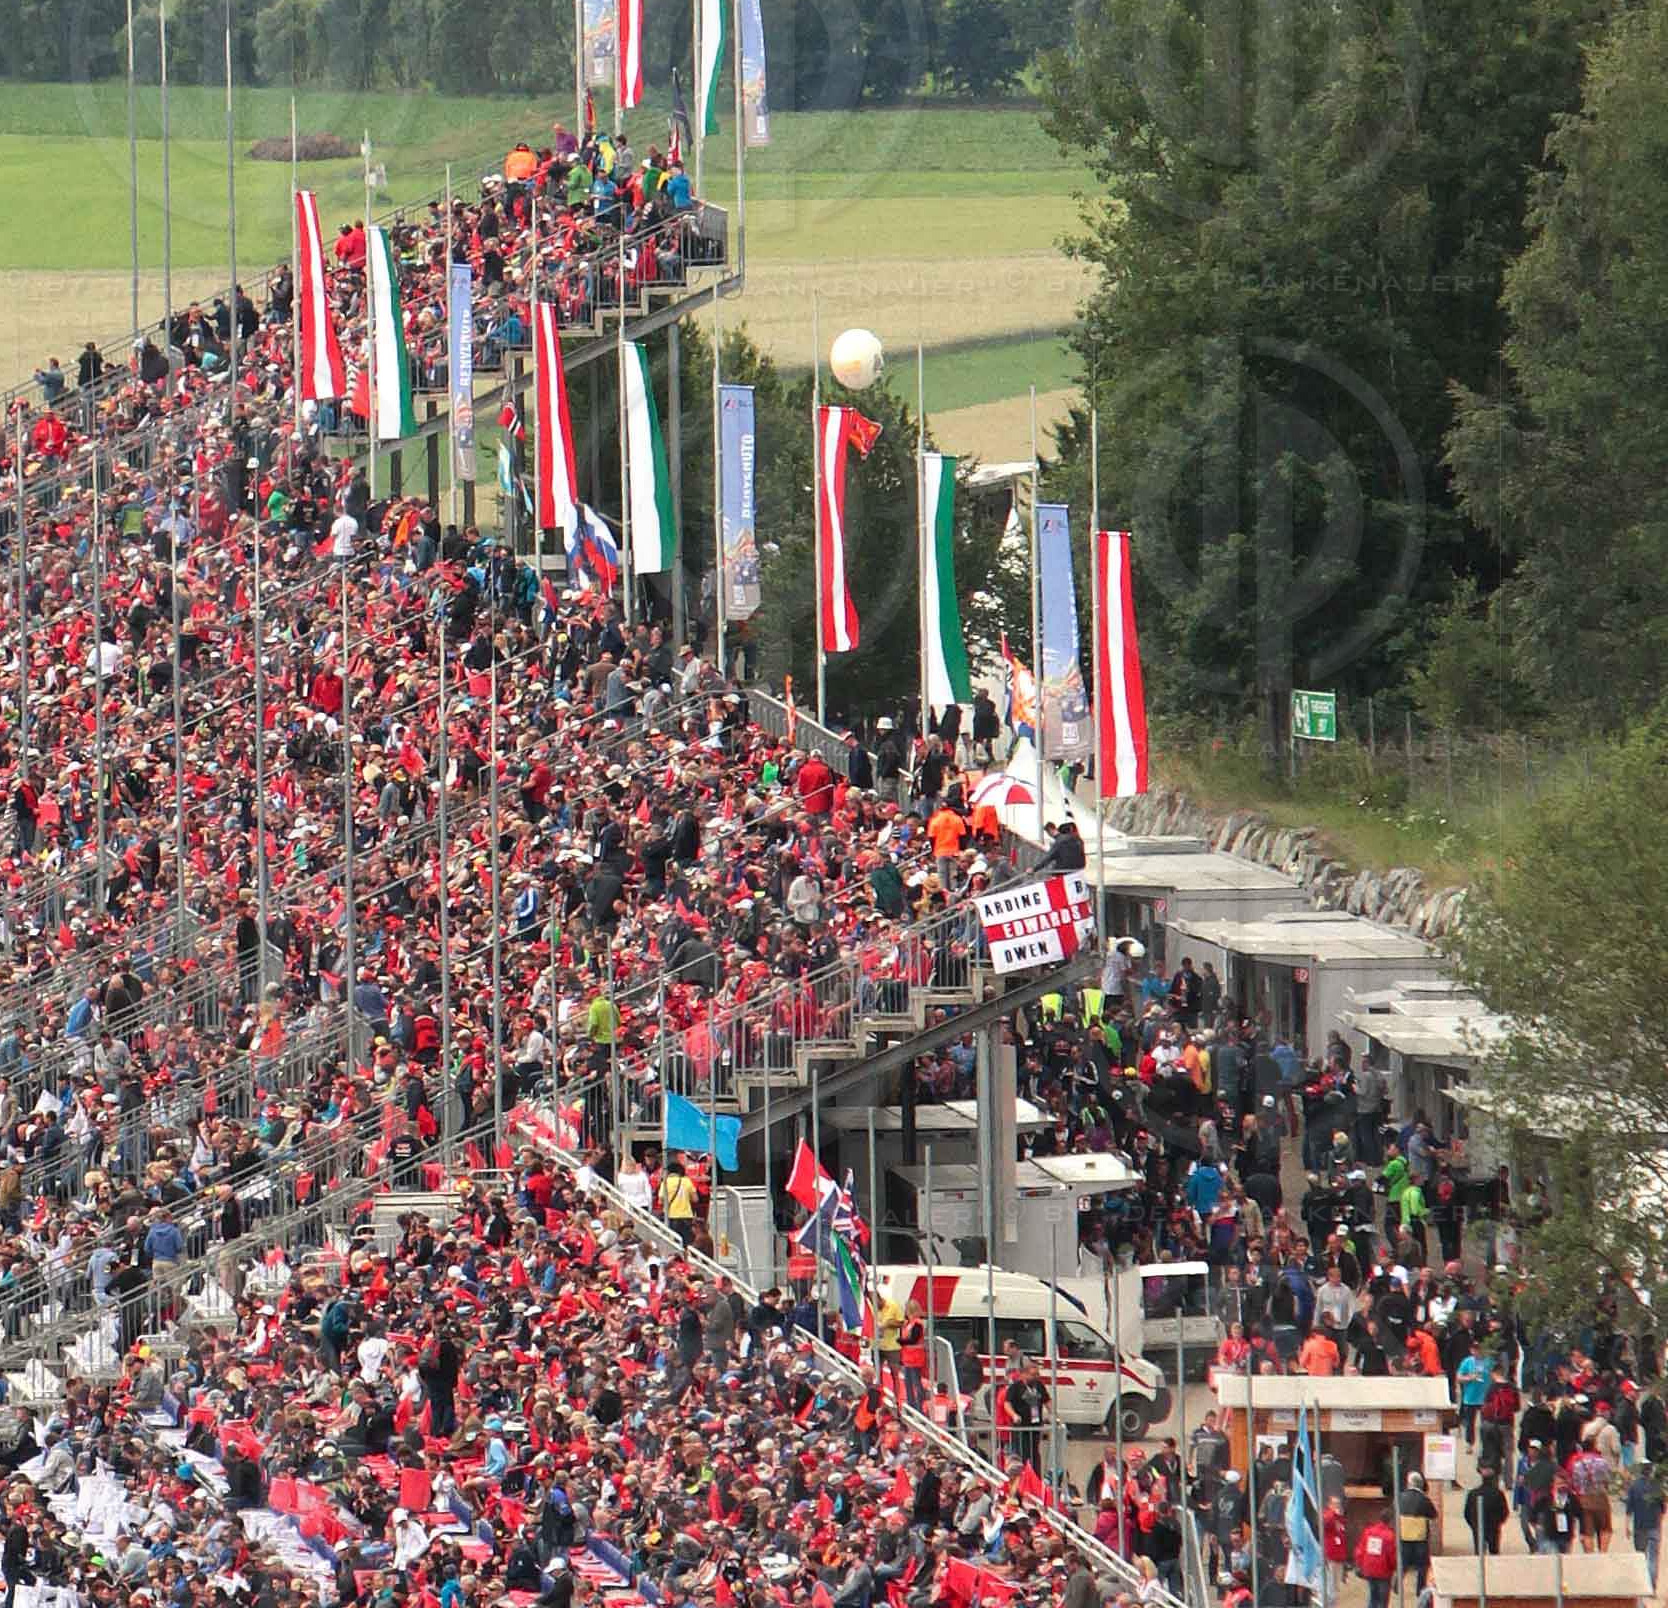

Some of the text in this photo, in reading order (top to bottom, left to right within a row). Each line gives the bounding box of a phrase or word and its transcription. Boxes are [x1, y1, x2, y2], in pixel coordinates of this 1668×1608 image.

[984, 892, 1042, 918] ARDING
[1003, 904, 1082, 938] EDWARDS
[1004, 941, 1049, 964] OWEN
